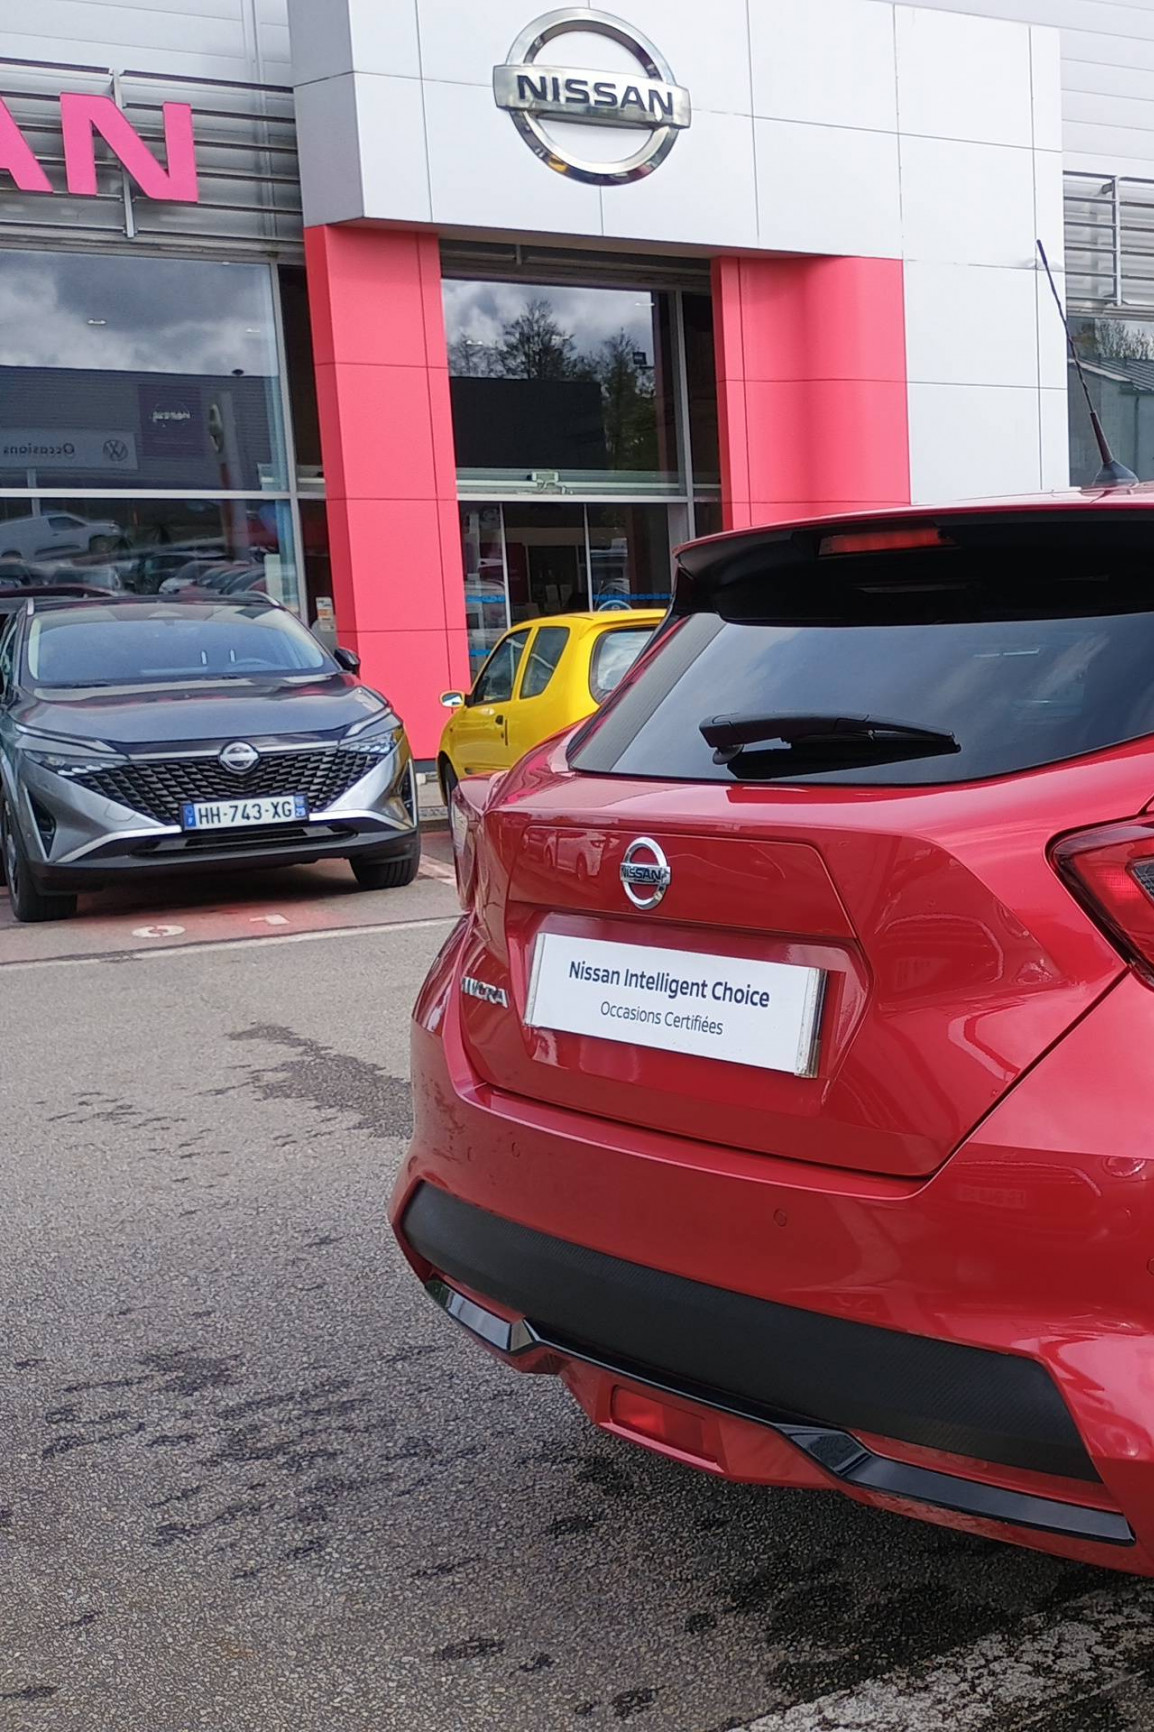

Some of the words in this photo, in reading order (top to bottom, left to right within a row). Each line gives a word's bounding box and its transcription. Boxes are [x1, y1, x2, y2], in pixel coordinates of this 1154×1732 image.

[516, 74, 673, 116] NISSAN
[198, 801, 292, 825] HH-743-XG
[621, 865, 661, 881] NISSAN
[568, 961, 621, 986] Nissan
[624, 968, 708, 999] Intelligent
[711, 981, 770, 1008] Choice
[600, 1001, 662, 1025] Occasions
[664, 1011, 724, 1036] Certifiées
